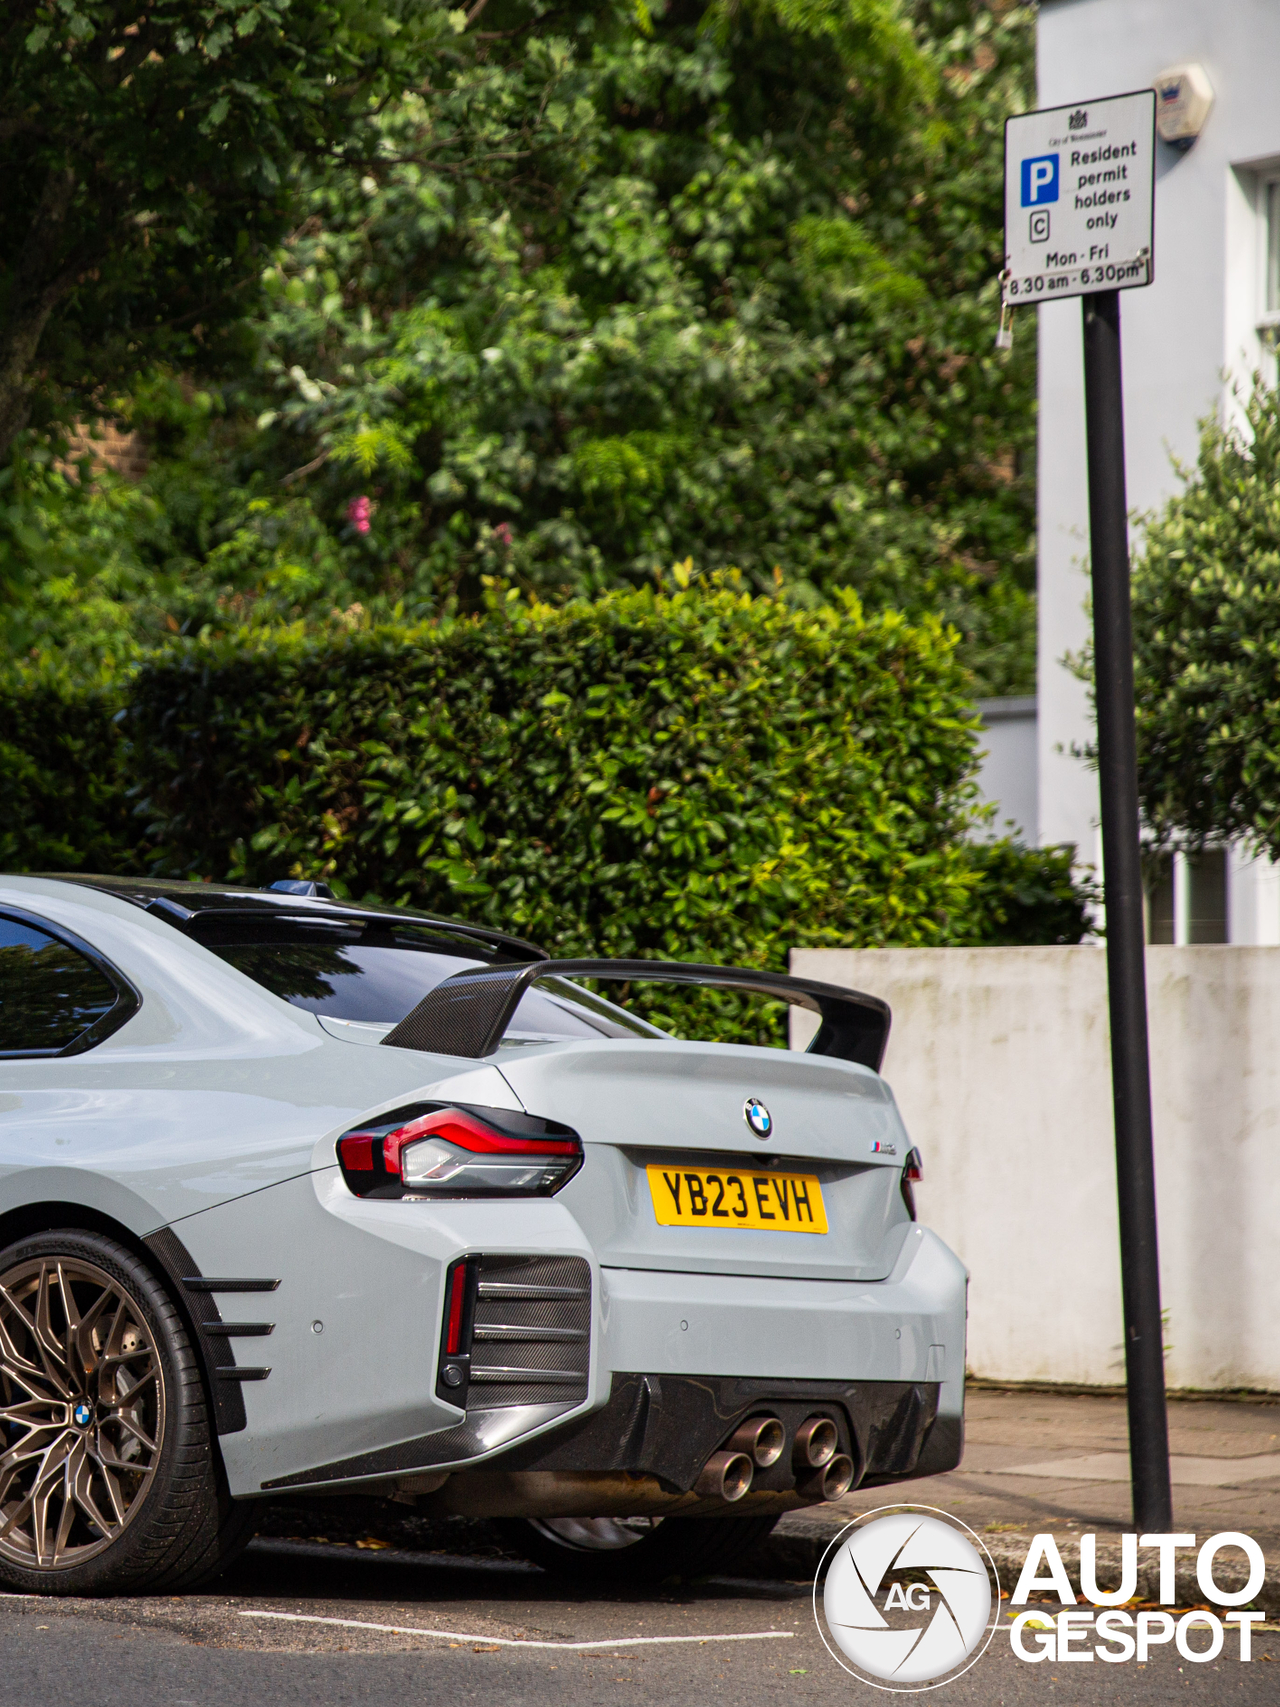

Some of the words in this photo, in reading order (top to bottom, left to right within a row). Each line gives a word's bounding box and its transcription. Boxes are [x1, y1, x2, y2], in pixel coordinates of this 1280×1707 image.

[1070, 140, 1137, 166] Resident
[1029, 159, 1054, 203] P
[1078, 164, 1128, 189] permit
[1075, 188, 1131, 210] holders
[1033, 218, 1046, 235] C
[1086, 212, 1118, 229] only
[1045, 251, 1077, 268] Mon
[1089, 243, 1109, 261] Fri
[1009, 275, 1044, 295] 8.30
[1047, 275, 1069, 289] am
[663, 1172, 748, 1218] YB23
[752, 1177, 814, 1222] EVH
